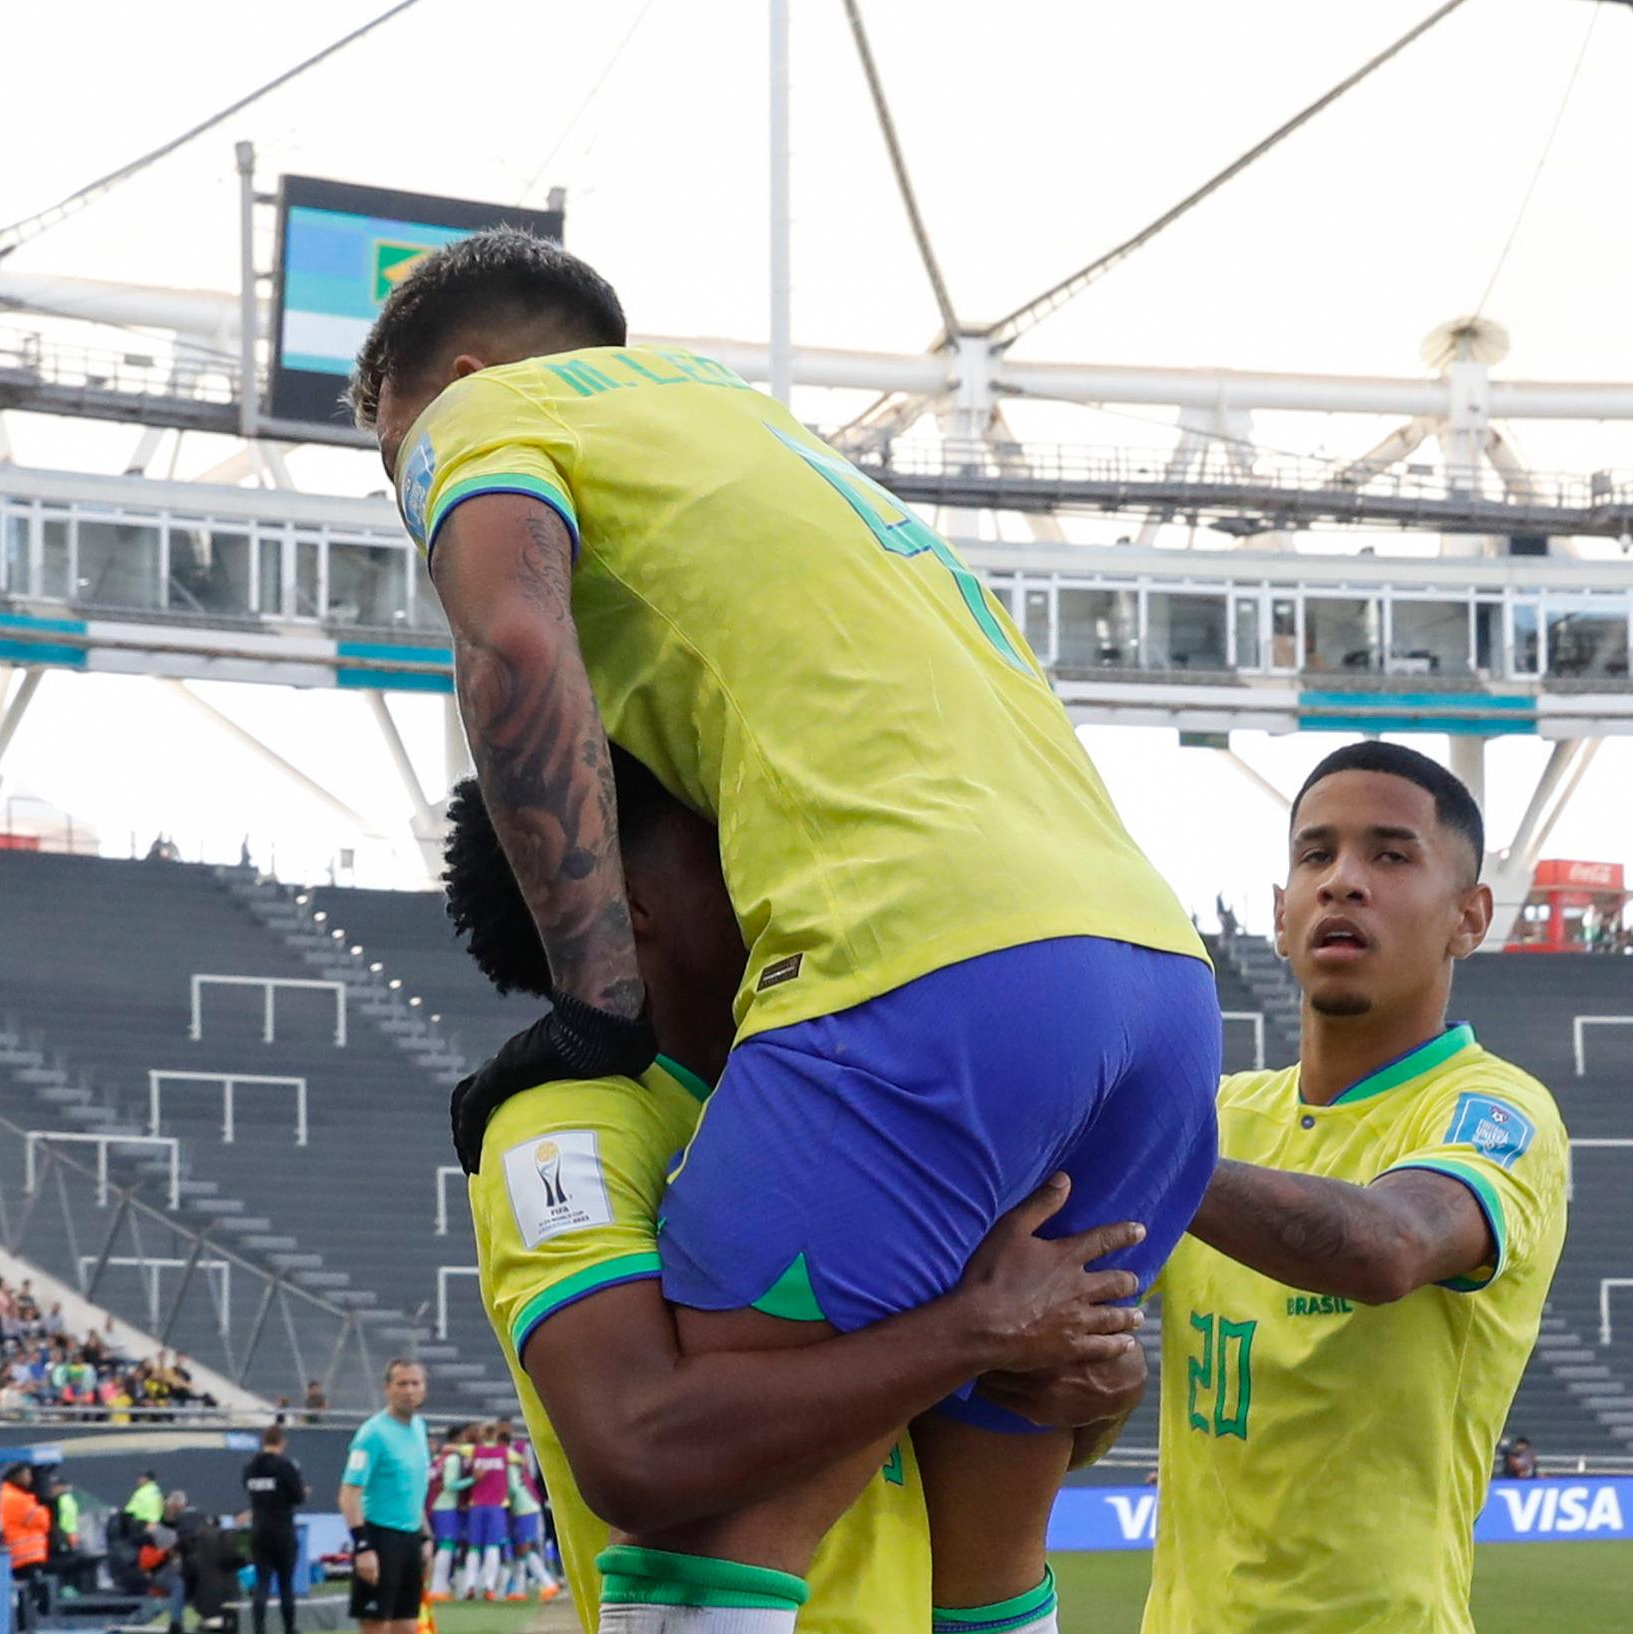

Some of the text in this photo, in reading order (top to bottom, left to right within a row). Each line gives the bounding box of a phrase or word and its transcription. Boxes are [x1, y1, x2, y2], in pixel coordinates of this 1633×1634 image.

[761, 420, 1039, 681] 4
[550, 1205, 570, 1216] FIFA
[1286, 1293, 1354, 1316] BRASIL
[1188, 1310, 1259, 1441] 20
[1495, 1486, 1624, 1533] VISA
